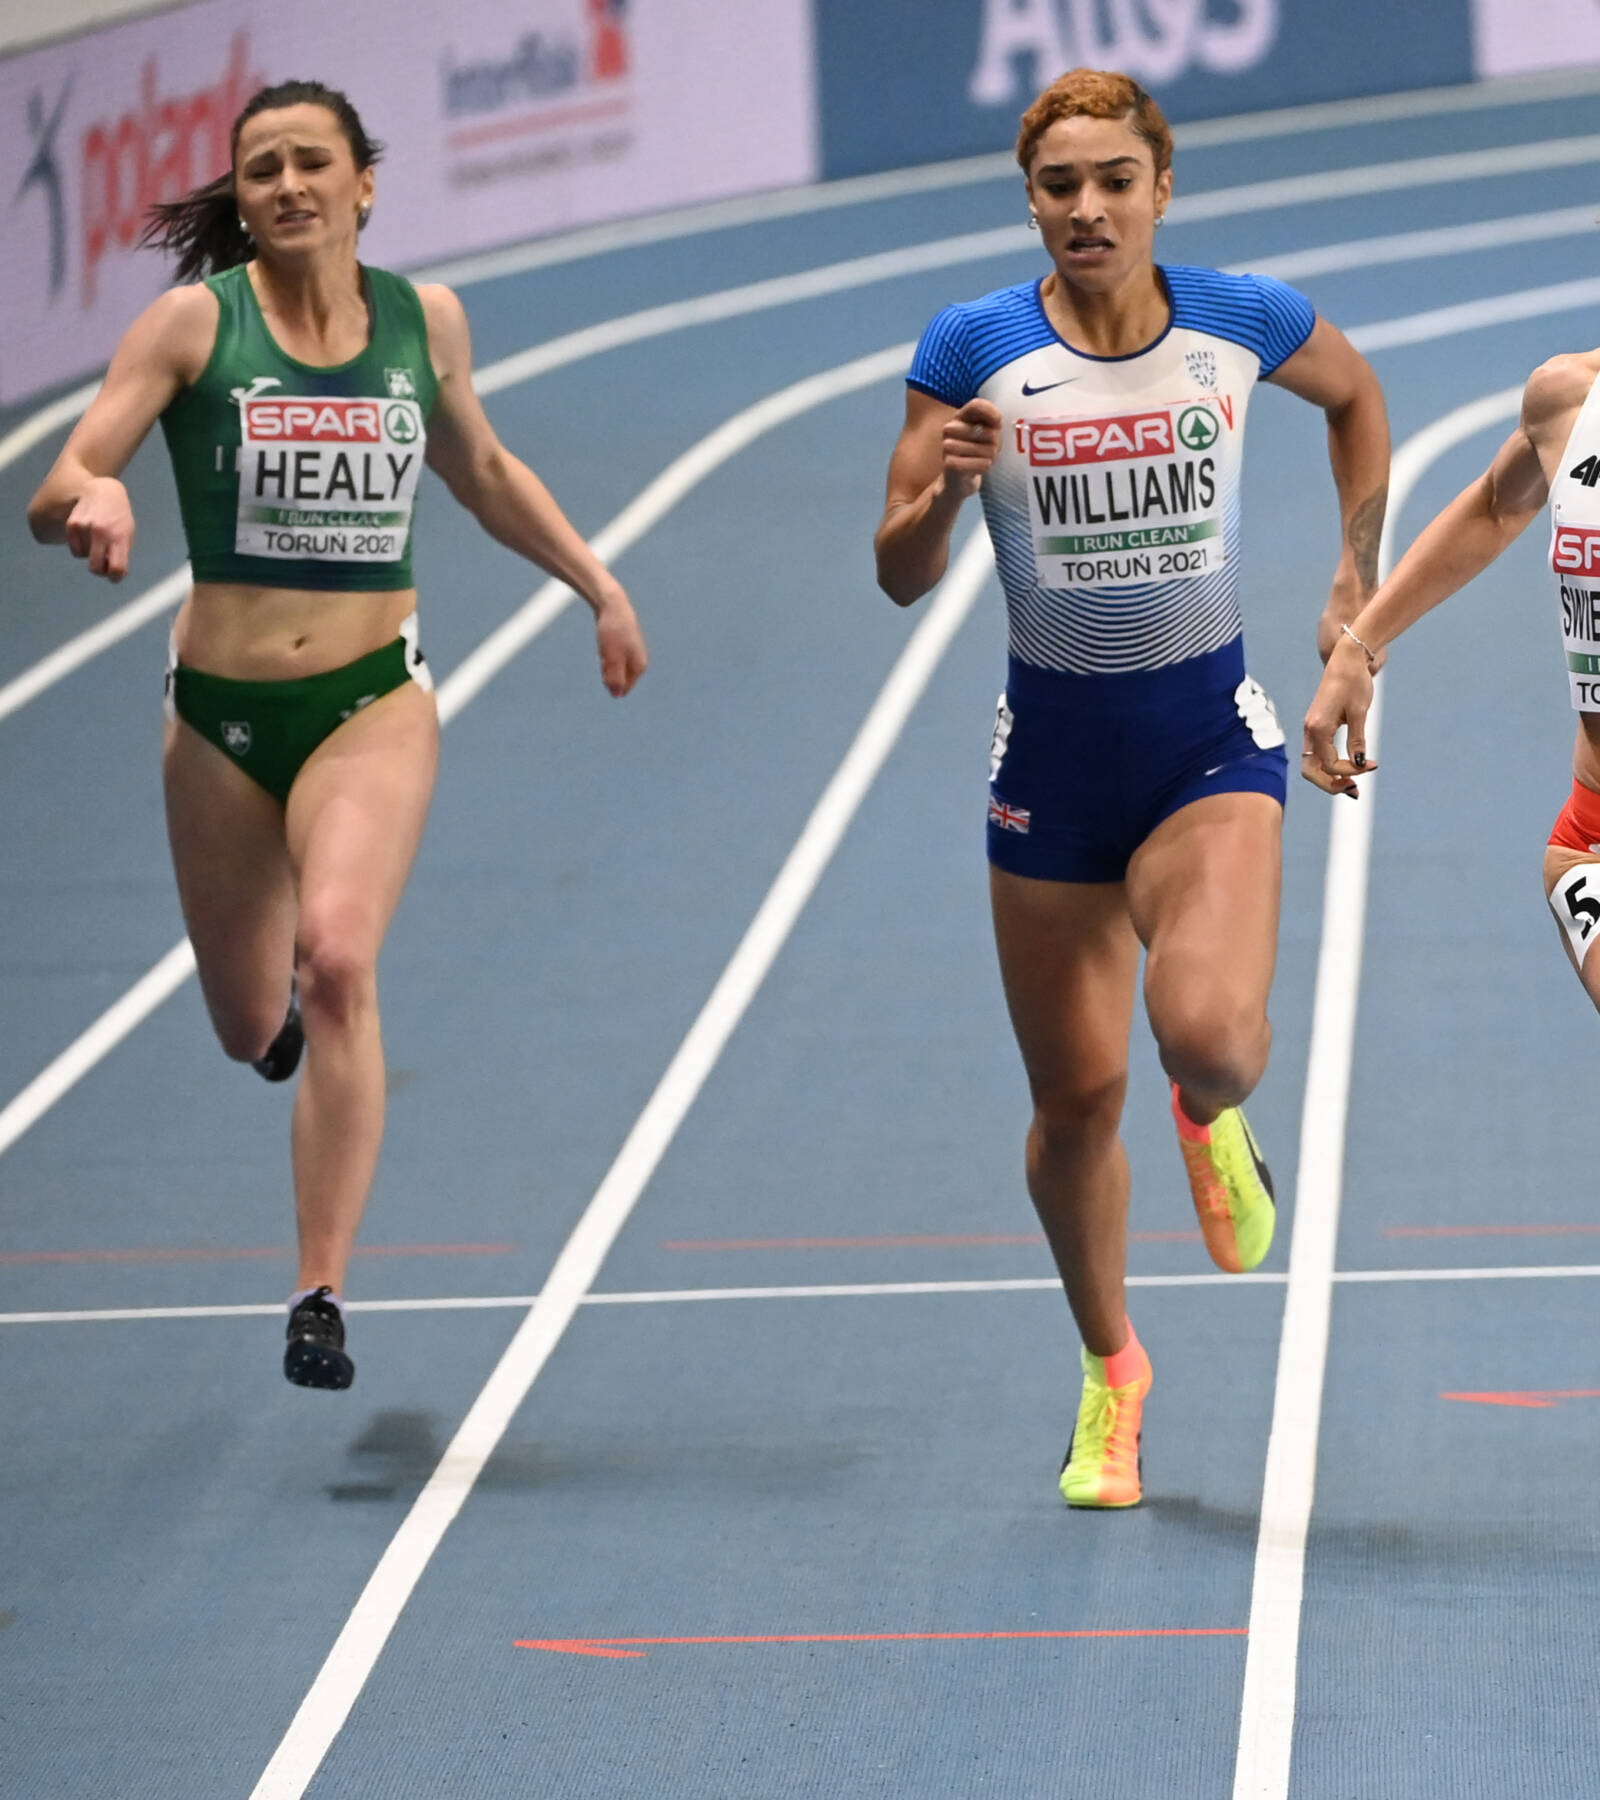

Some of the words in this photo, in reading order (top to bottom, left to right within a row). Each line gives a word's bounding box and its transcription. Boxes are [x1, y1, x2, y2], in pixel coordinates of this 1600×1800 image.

[250, 406, 378, 437] SPAR
[1032, 417, 1170, 461] SPAR
[255, 451, 413, 501] HEALY
[1033, 458, 1215, 526] WILLIAMS
[264, 531, 346, 553] TORUŃ
[353, 534, 395, 554] 2021
[1084, 534, 1123, 551] RUN
[1062, 553, 1151, 581] TORUŃ
[1158, 549, 1207, 574] 2021
[1588, 657, 1593, 671] I
